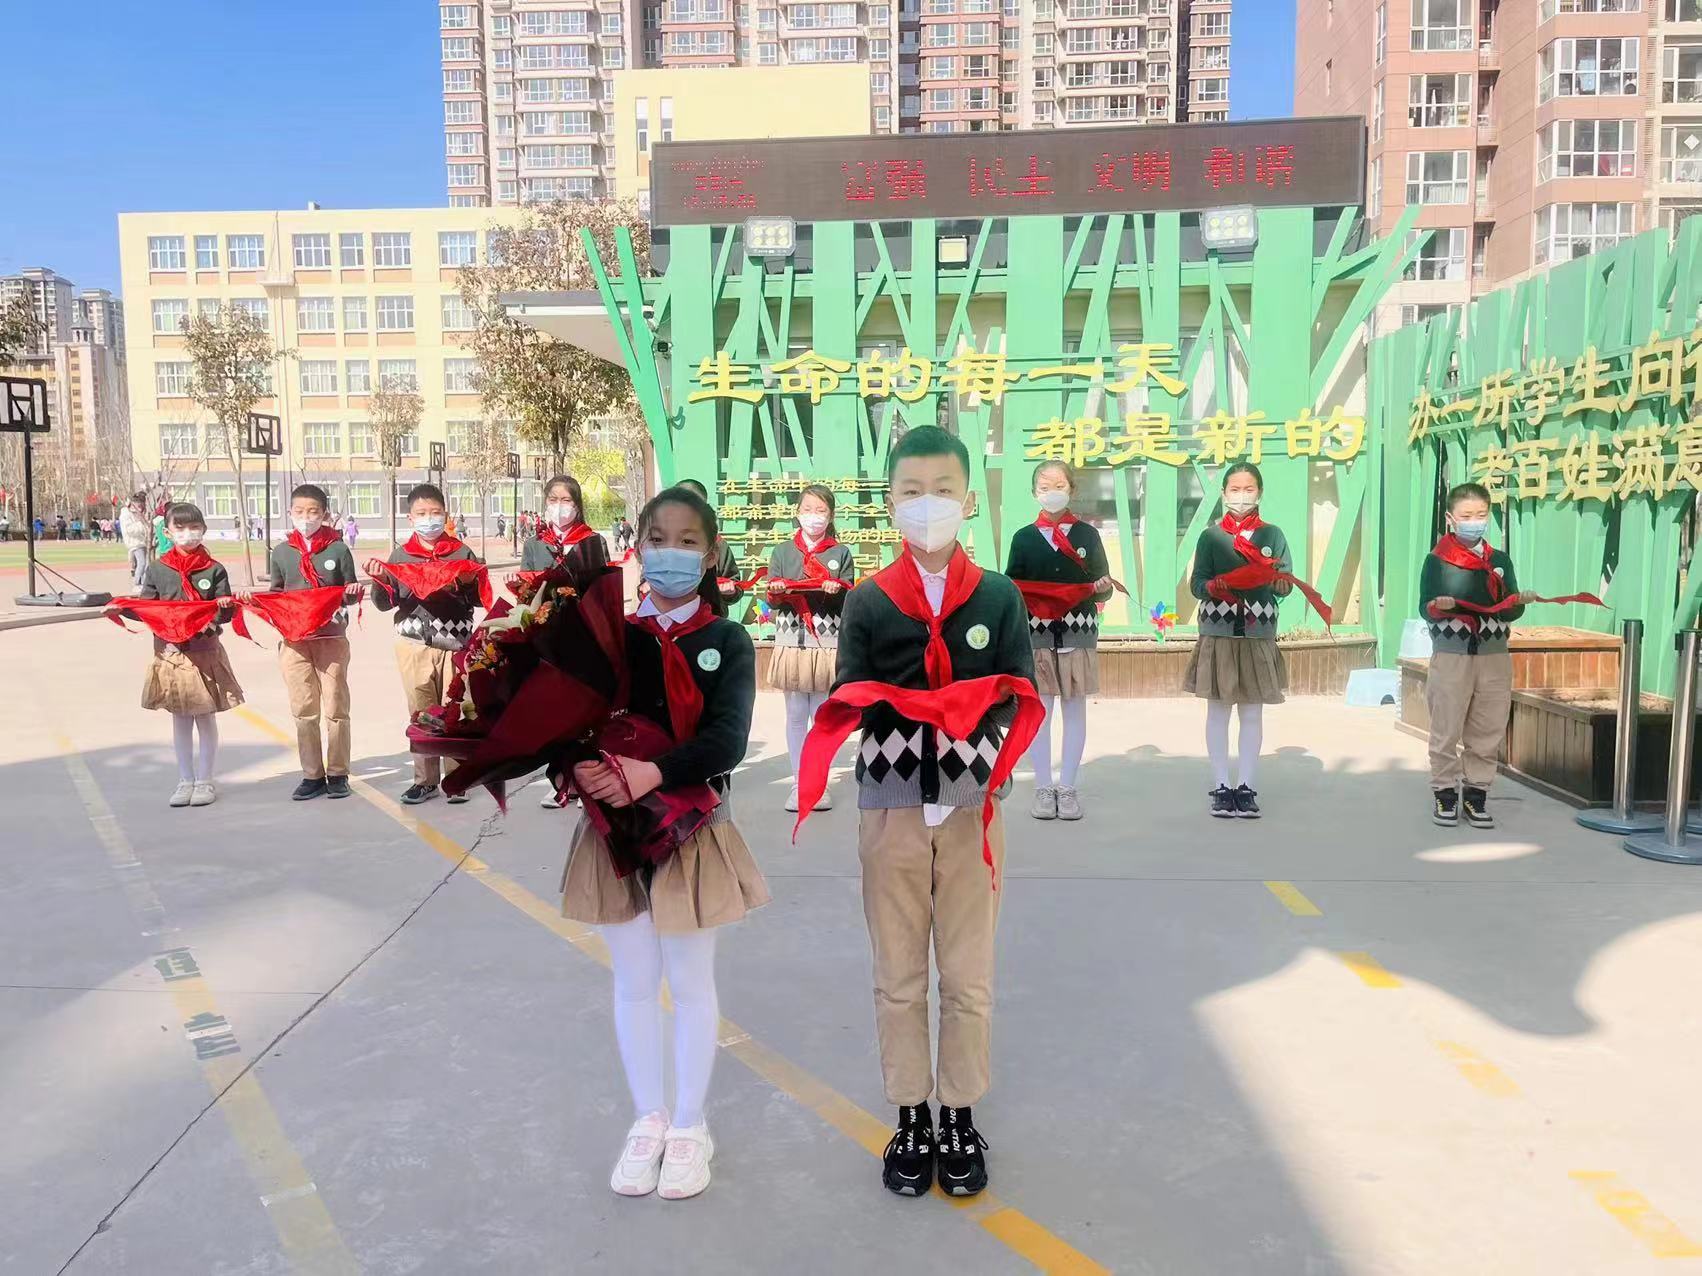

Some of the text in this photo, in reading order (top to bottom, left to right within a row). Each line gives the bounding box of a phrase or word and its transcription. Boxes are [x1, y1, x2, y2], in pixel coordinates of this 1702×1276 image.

[1087, 151, 1170, 193] 文明
[688, 343, 1188, 405] 生命的每一天
[1027, 405, 1368, 468] 都是新的
